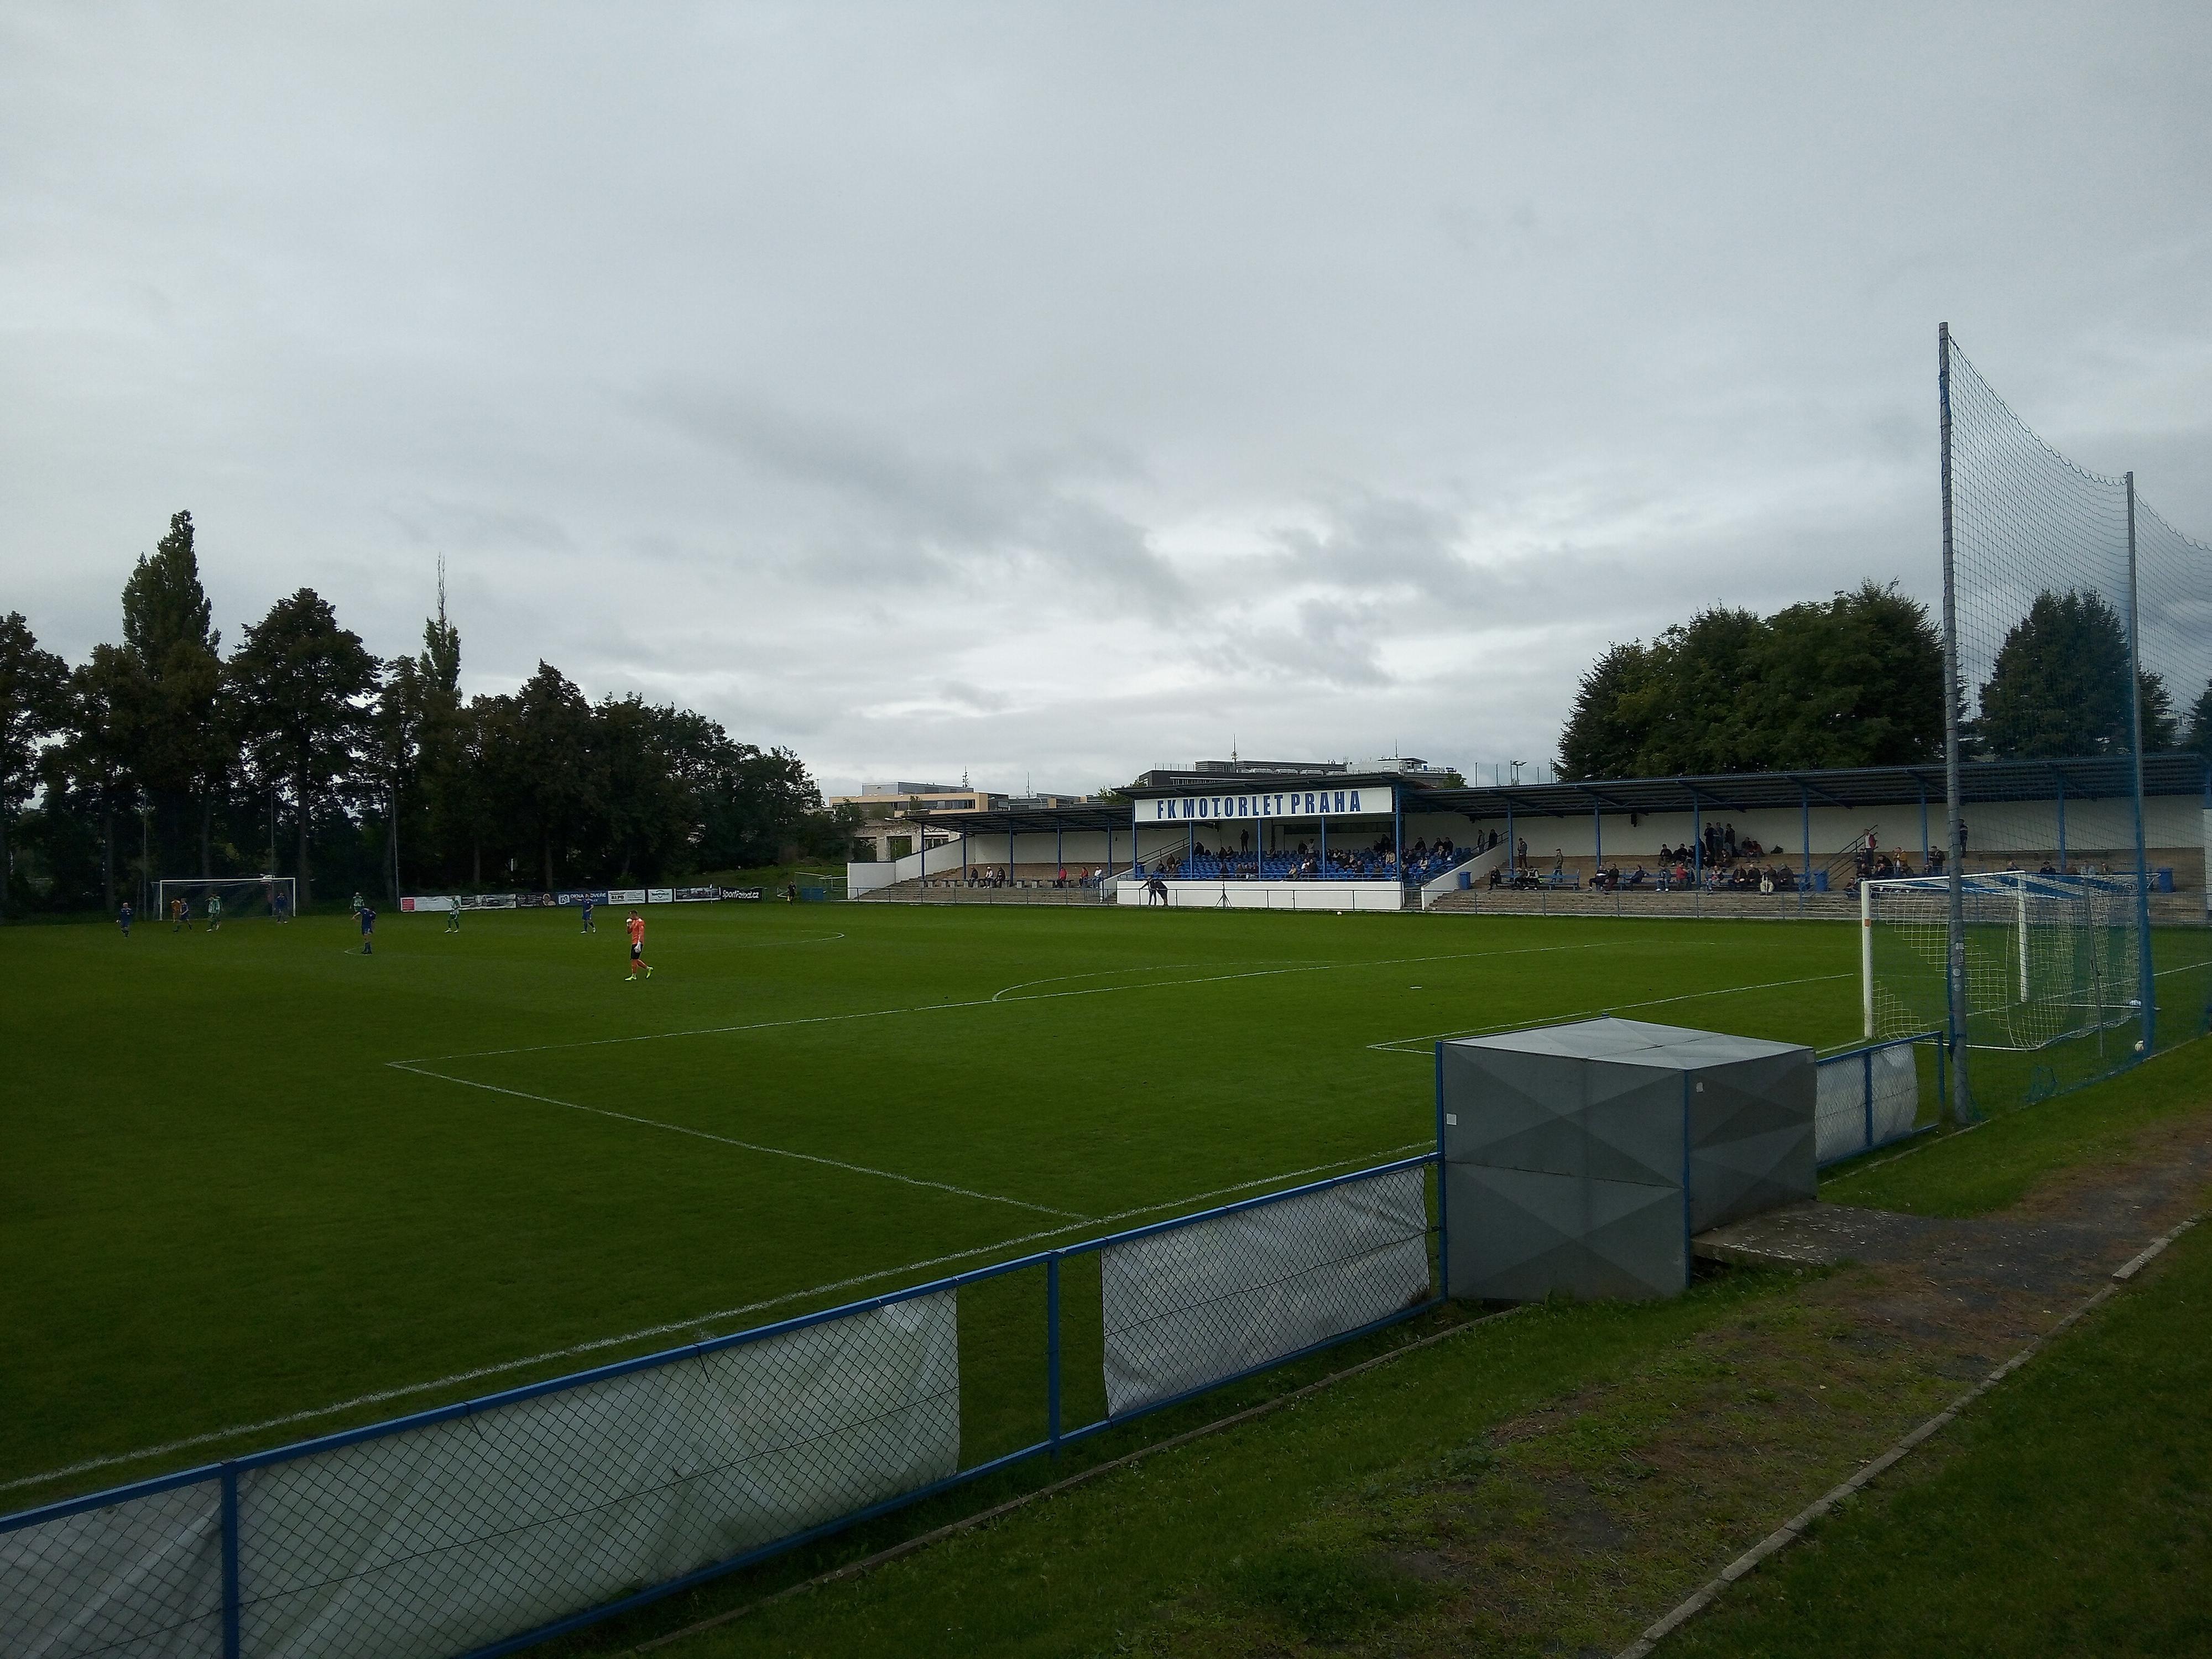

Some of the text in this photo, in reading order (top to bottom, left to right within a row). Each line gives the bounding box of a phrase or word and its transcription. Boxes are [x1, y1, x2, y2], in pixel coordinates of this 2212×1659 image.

[1157, 791, 1361, 819] FK MOTORLET PRAHA
